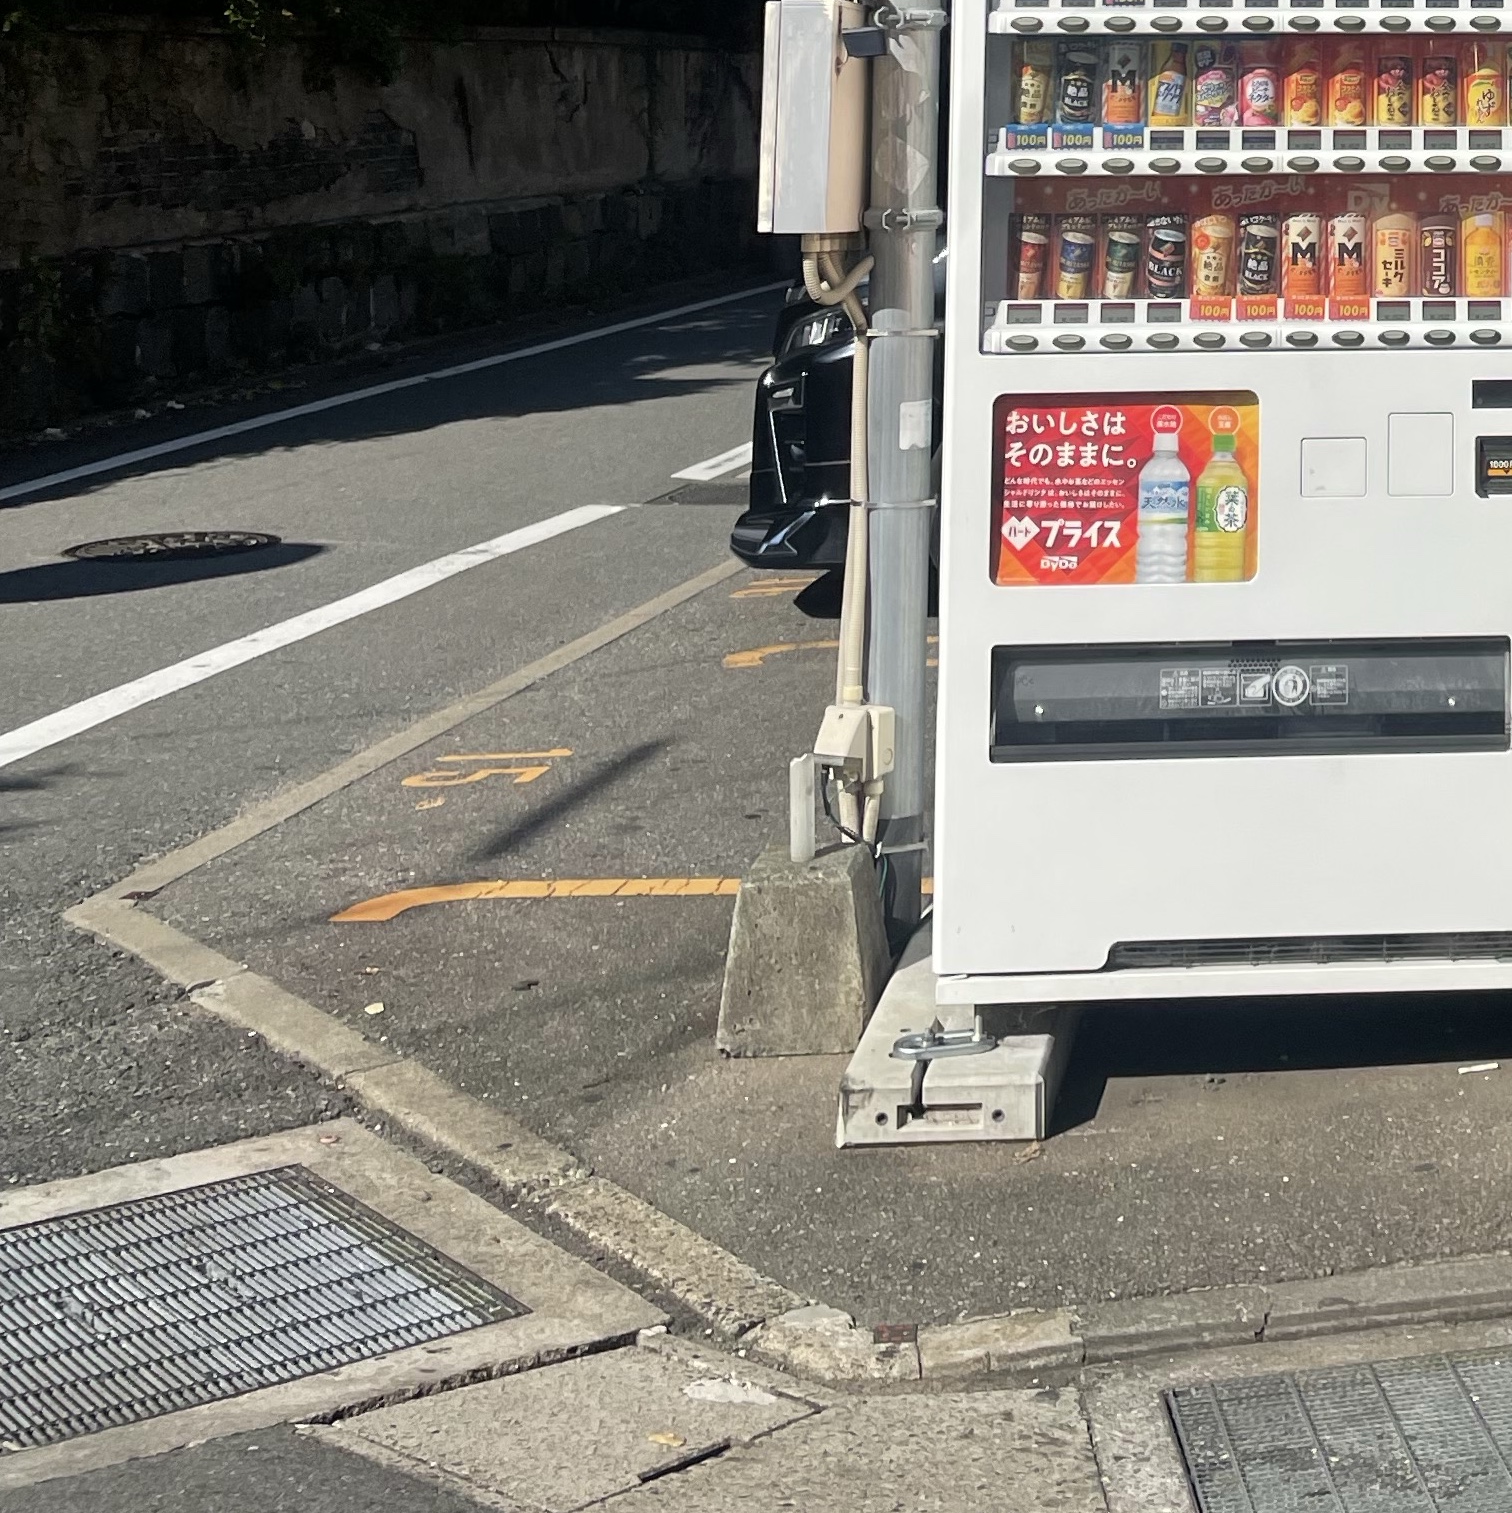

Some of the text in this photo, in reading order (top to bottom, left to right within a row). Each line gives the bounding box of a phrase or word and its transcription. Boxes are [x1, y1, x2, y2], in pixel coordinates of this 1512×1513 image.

[1016, 135, 1046, 146] 100円
[1063, 135, 1092, 146] 100円
[1113, 135, 1143, 146] 100円
[1148, 262, 1183, 276] BLACK
[1431, 248, 1446, 289] ココア
[1200, 304, 1230, 317] 100円
[1246, 304, 1276, 316] 100円
[1294, 303, 1323, 316] 100円
[1339, 303, 1368, 316] 100円
[1005, 411, 1127, 437] おいしさは
[1004, 441, 1138, 469] そのままに。
[1008, 518, 1122, 548] ハート プライス
[1040, 555, 1078, 572] DyDo
